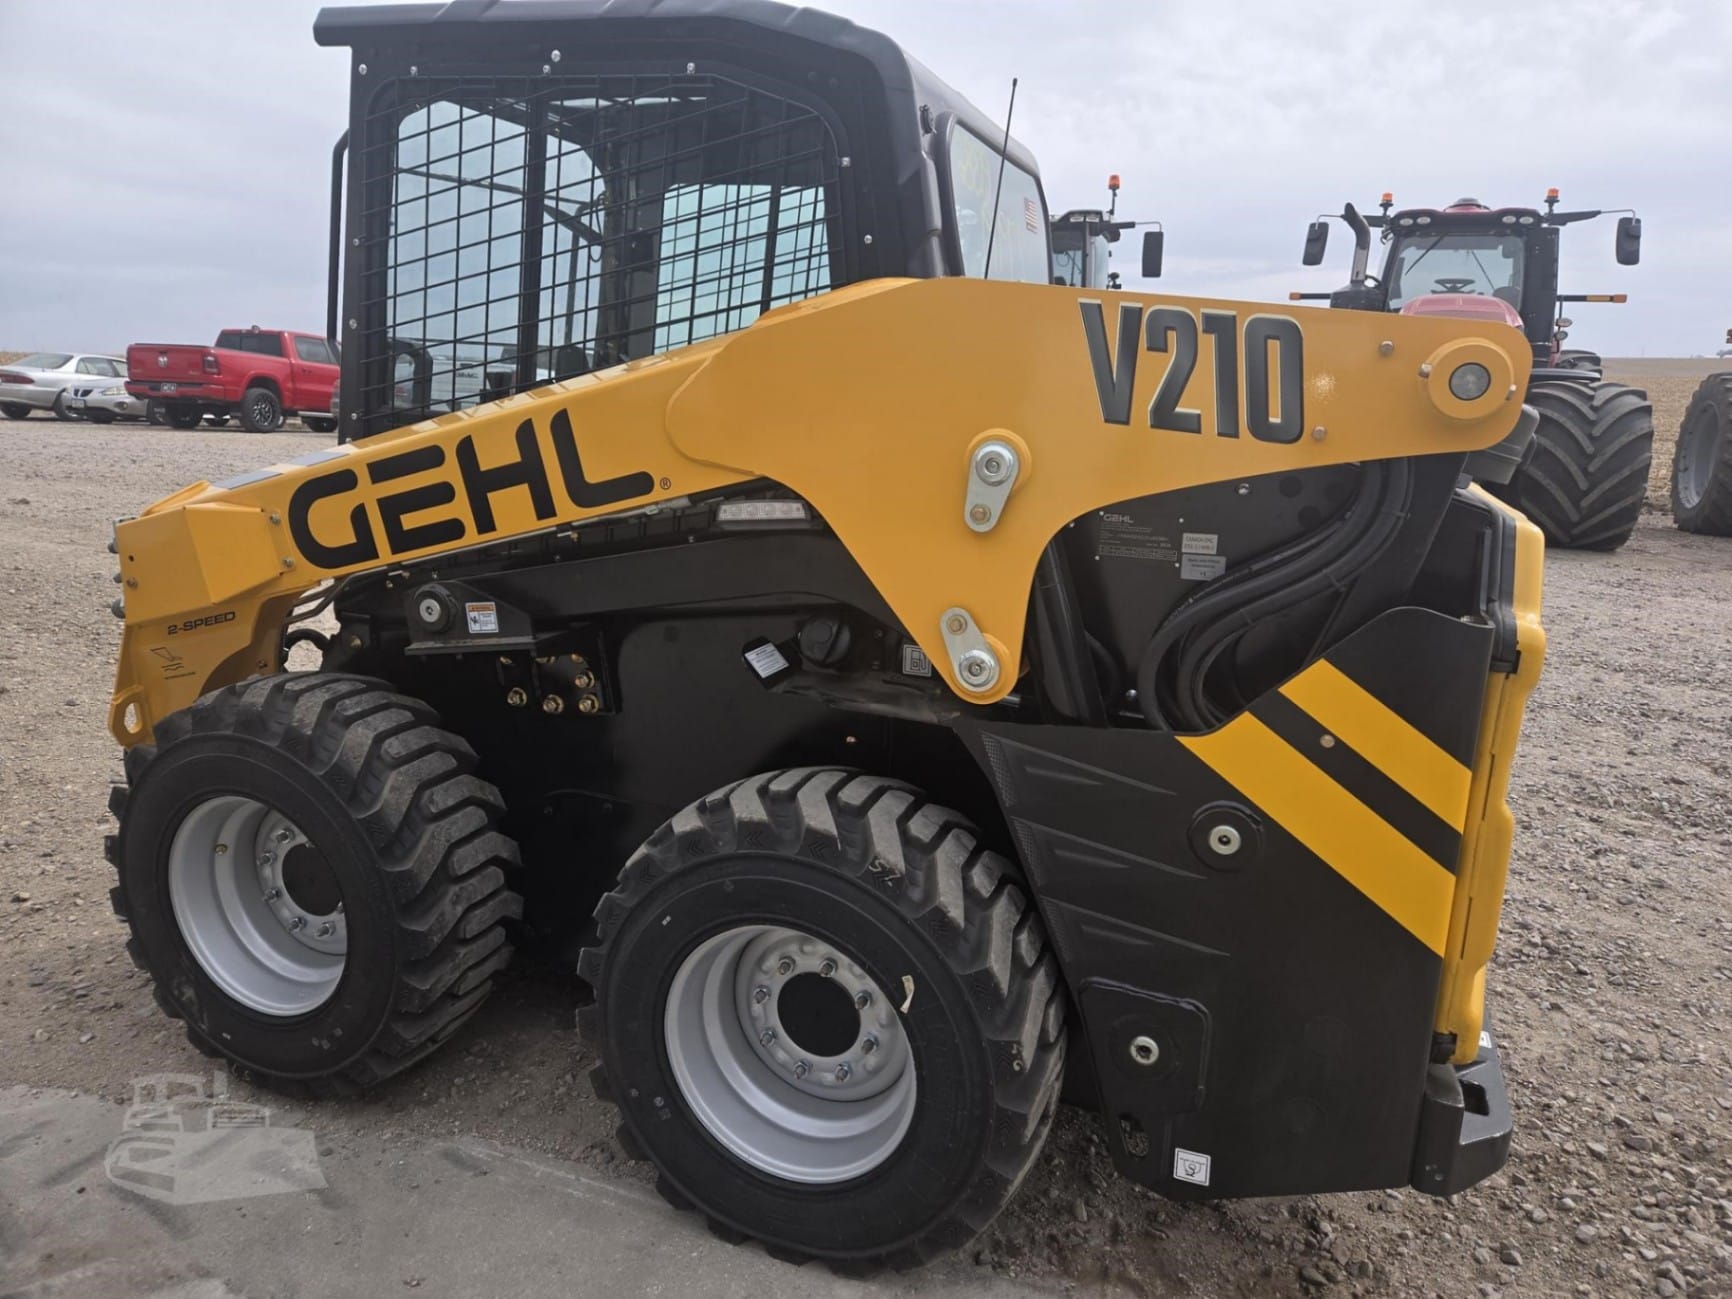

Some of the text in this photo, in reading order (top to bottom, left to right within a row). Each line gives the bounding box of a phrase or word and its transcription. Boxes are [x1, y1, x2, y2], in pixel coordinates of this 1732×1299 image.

[1077, 298, 1304, 445] V210
[288, 408, 655, 570] GEHL
[1103, 513, 1134, 524] GEHL
[167, 611, 236, 636] 2-SPEED
